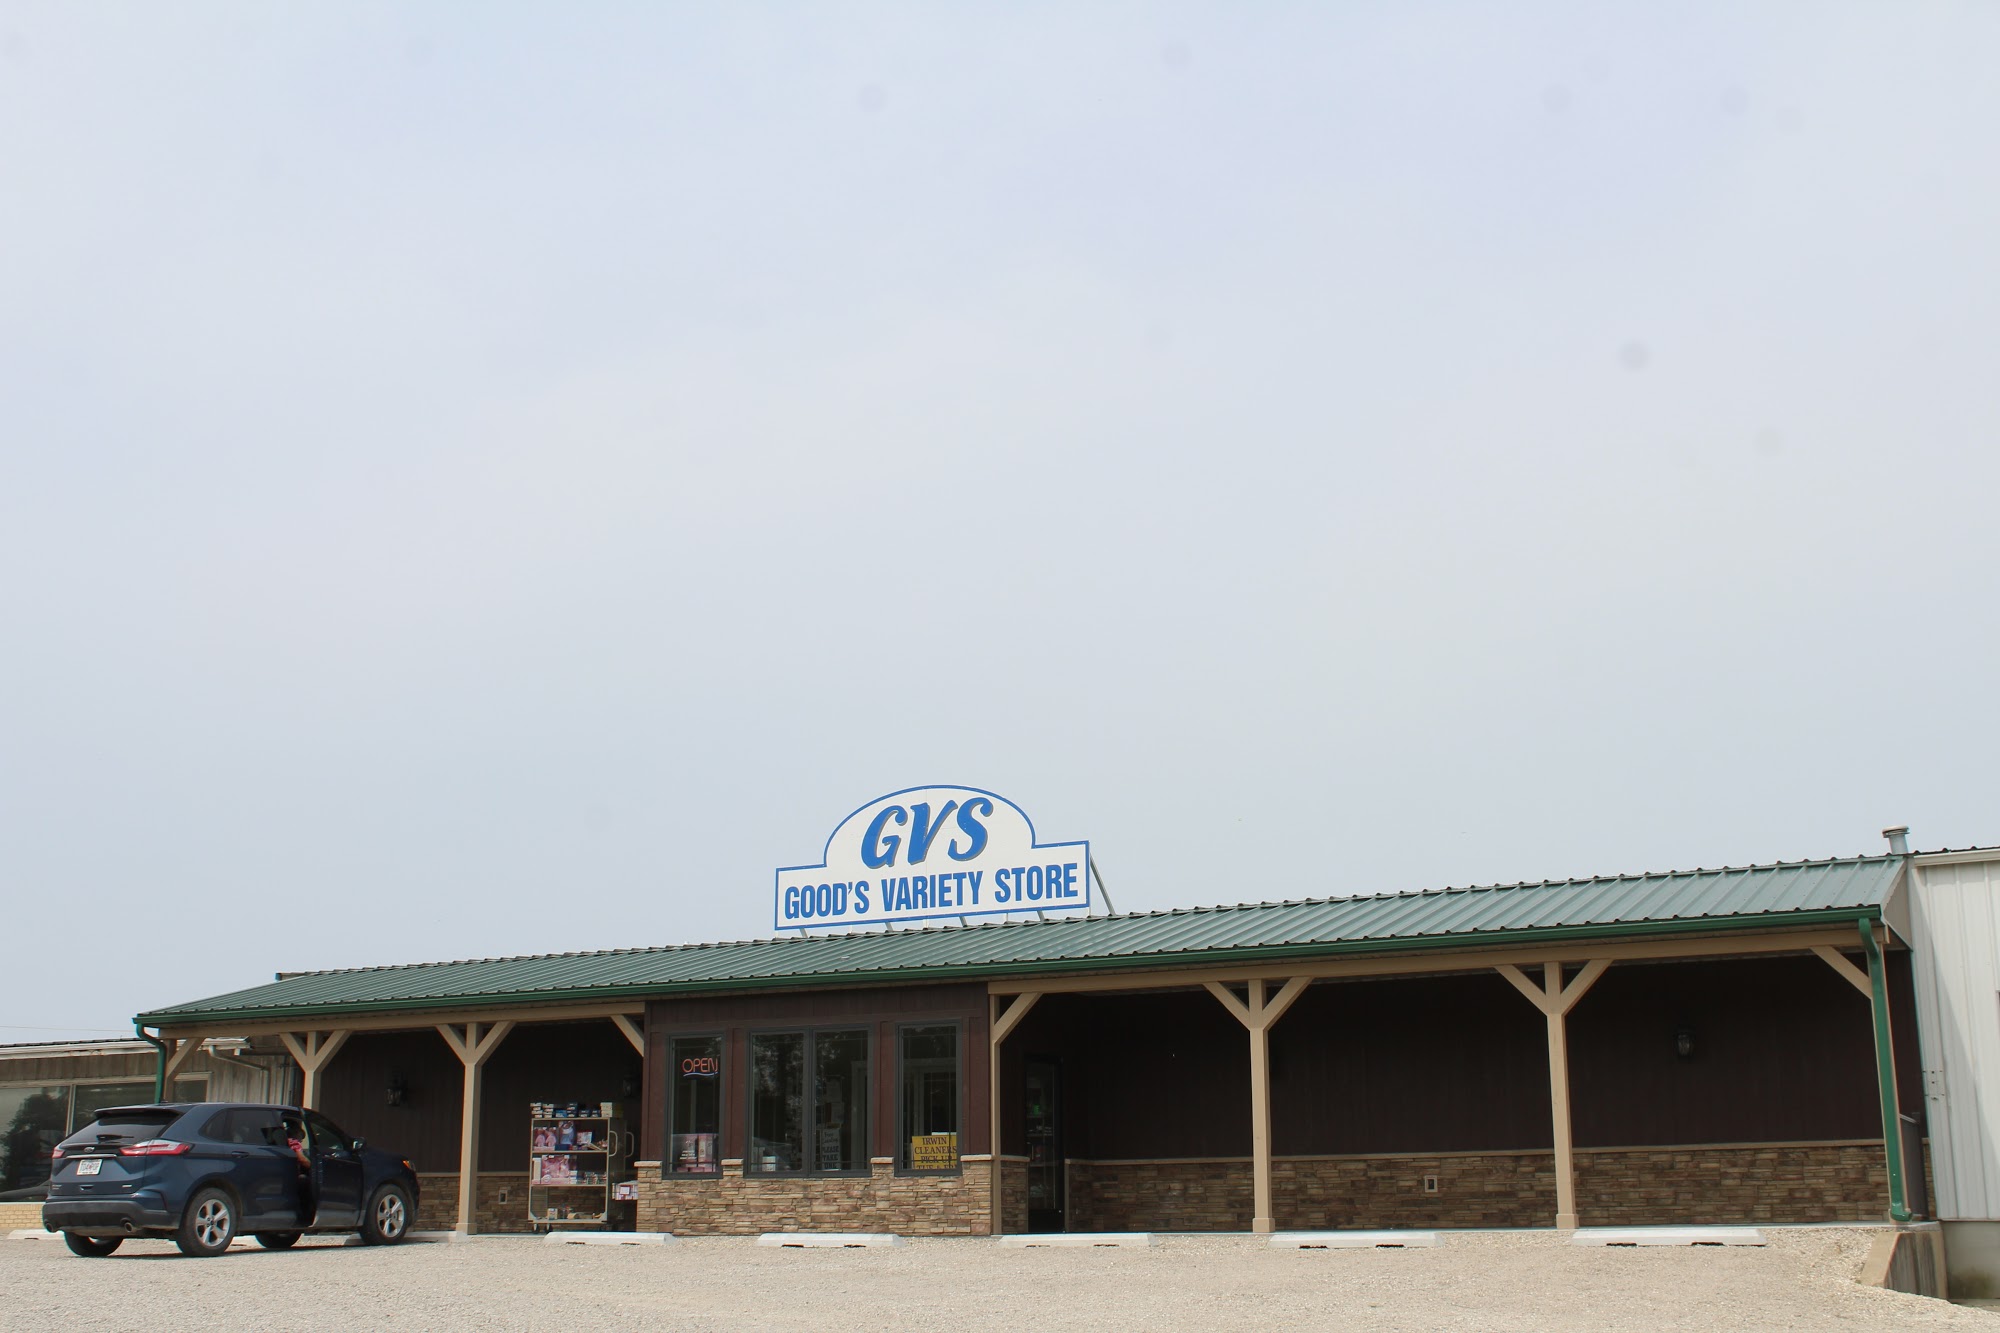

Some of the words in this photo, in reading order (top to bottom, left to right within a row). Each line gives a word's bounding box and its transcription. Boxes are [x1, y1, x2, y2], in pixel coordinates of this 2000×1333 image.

[860, 796, 994, 869] GVS
[784, 879, 870, 920] GOOD'S
[881, 870, 984, 912] VARIETY
[994, 862, 1079, 904] STORE
[682, 1057, 719, 1073] OPEN
[922, 1136, 947, 1146] IRWIN
[914, 1145, 957, 1155] CLEANERS
